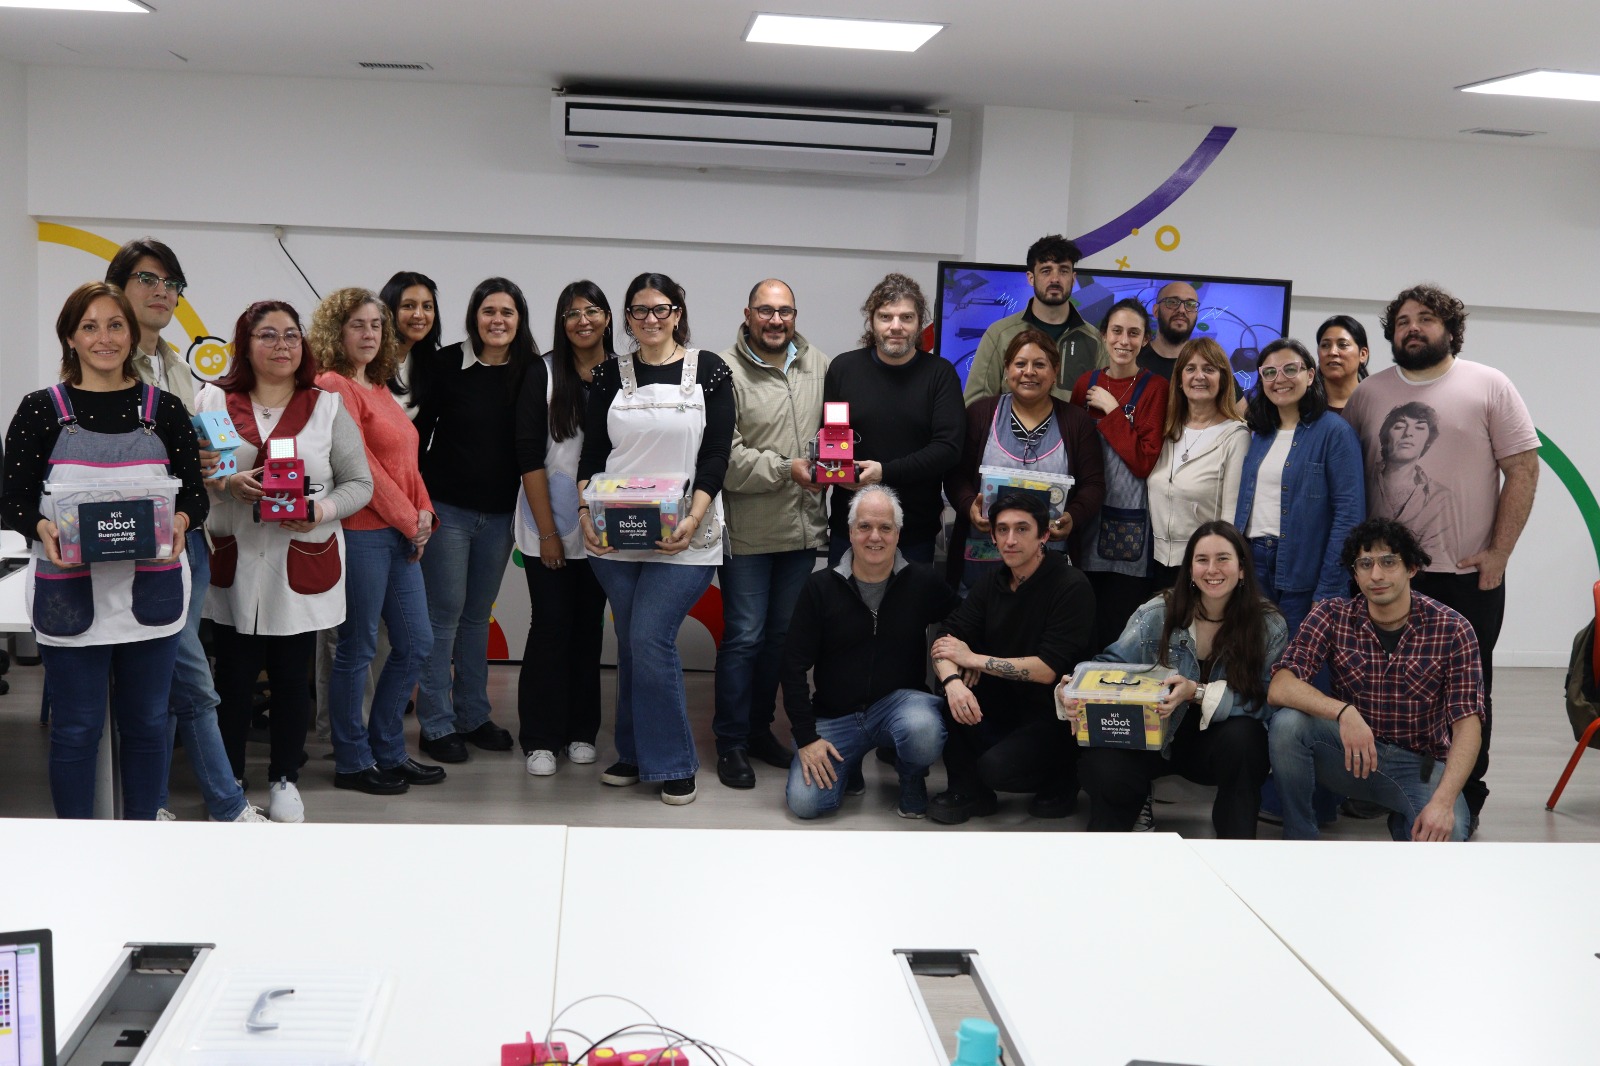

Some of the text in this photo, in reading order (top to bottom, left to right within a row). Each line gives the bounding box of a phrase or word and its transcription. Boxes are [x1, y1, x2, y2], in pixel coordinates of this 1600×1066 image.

[97, 517, 136, 531] Robot
[619, 519, 647, 528] Robot
[1100, 717, 1131, 727] Robot
